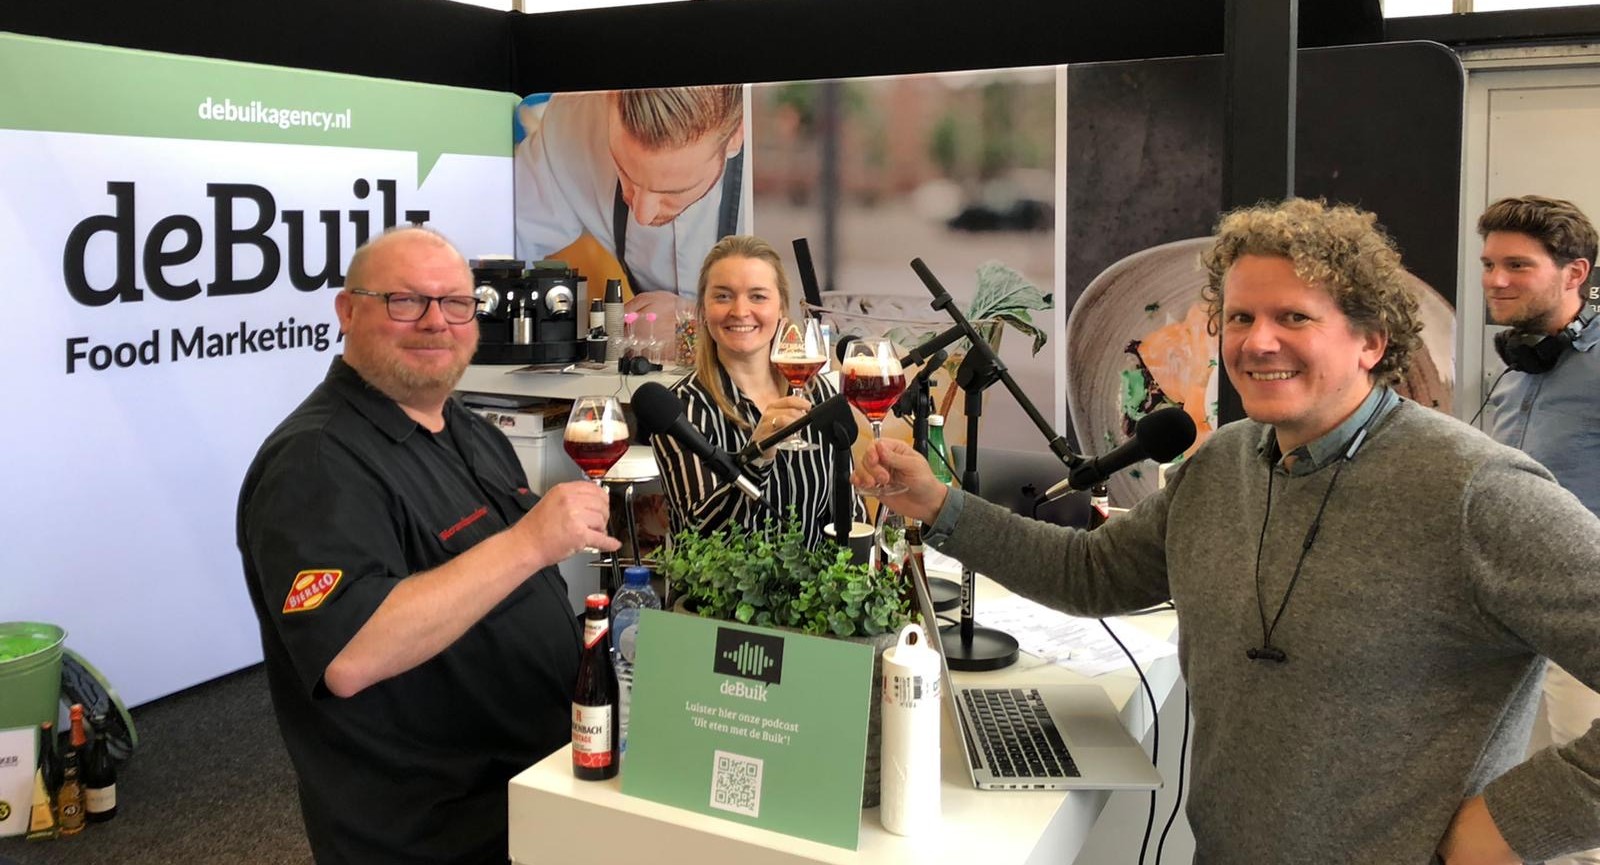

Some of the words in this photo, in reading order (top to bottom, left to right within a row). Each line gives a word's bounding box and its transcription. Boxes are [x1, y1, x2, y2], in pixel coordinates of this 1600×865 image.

[198, 97, 352, 131] debuikagency.nl
[66, 329, 161, 375] Food
[170, 317, 330, 362] Marketing
[289, 572, 334, 608] BIER&CO
[719, 679, 769, 702] deBuik
[685, 700, 717, 717] Luister
[718, 707, 738, 721] hier
[738, 713, 761, 726] onze
[761, 717, 800, 733] podcast
[708, 721, 729, 734] eten
[729, 725, 748, 738] met
[749, 729, 761, 741] de
